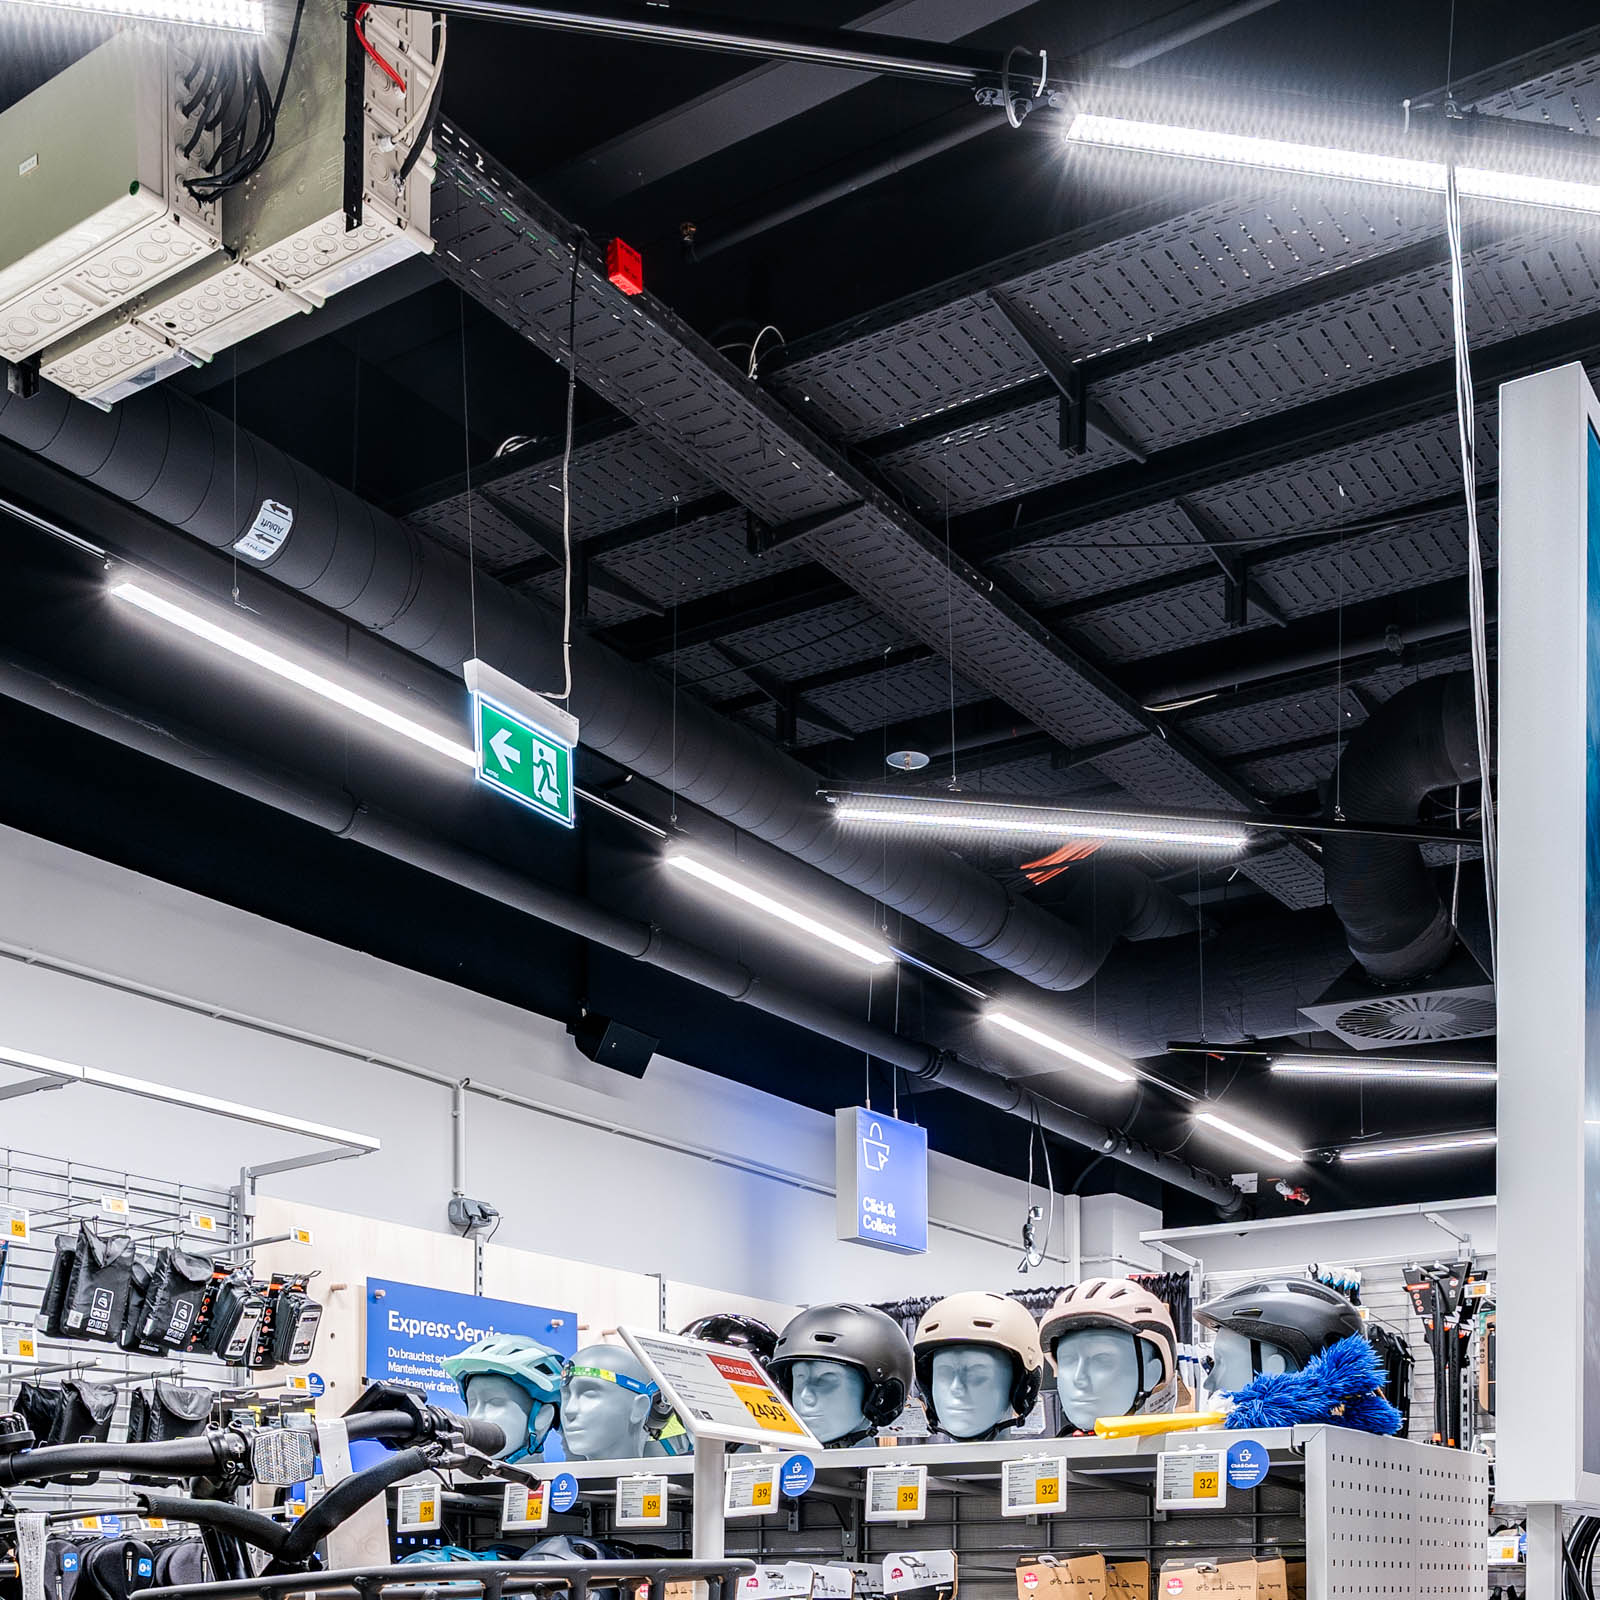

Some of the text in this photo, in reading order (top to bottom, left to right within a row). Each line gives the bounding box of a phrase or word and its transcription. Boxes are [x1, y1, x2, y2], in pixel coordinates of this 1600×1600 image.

[261, 518, 284, 534] Abluft
[863, 1196, 896, 1218] Click &
[863, 1214, 897, 1236] Collect
[388, 1347, 400, 1357] Du
[400, 1347, 434, 1363] brauchst
[388, 1361, 445, 1378] Mantelwechsel
[717, 1362, 758, 1379] REDUZIERT
[424, 1380, 436, 1391] wir
[436, 1381, 460, 1395] direkt
[745, 1400, 783, 1422] 2499
